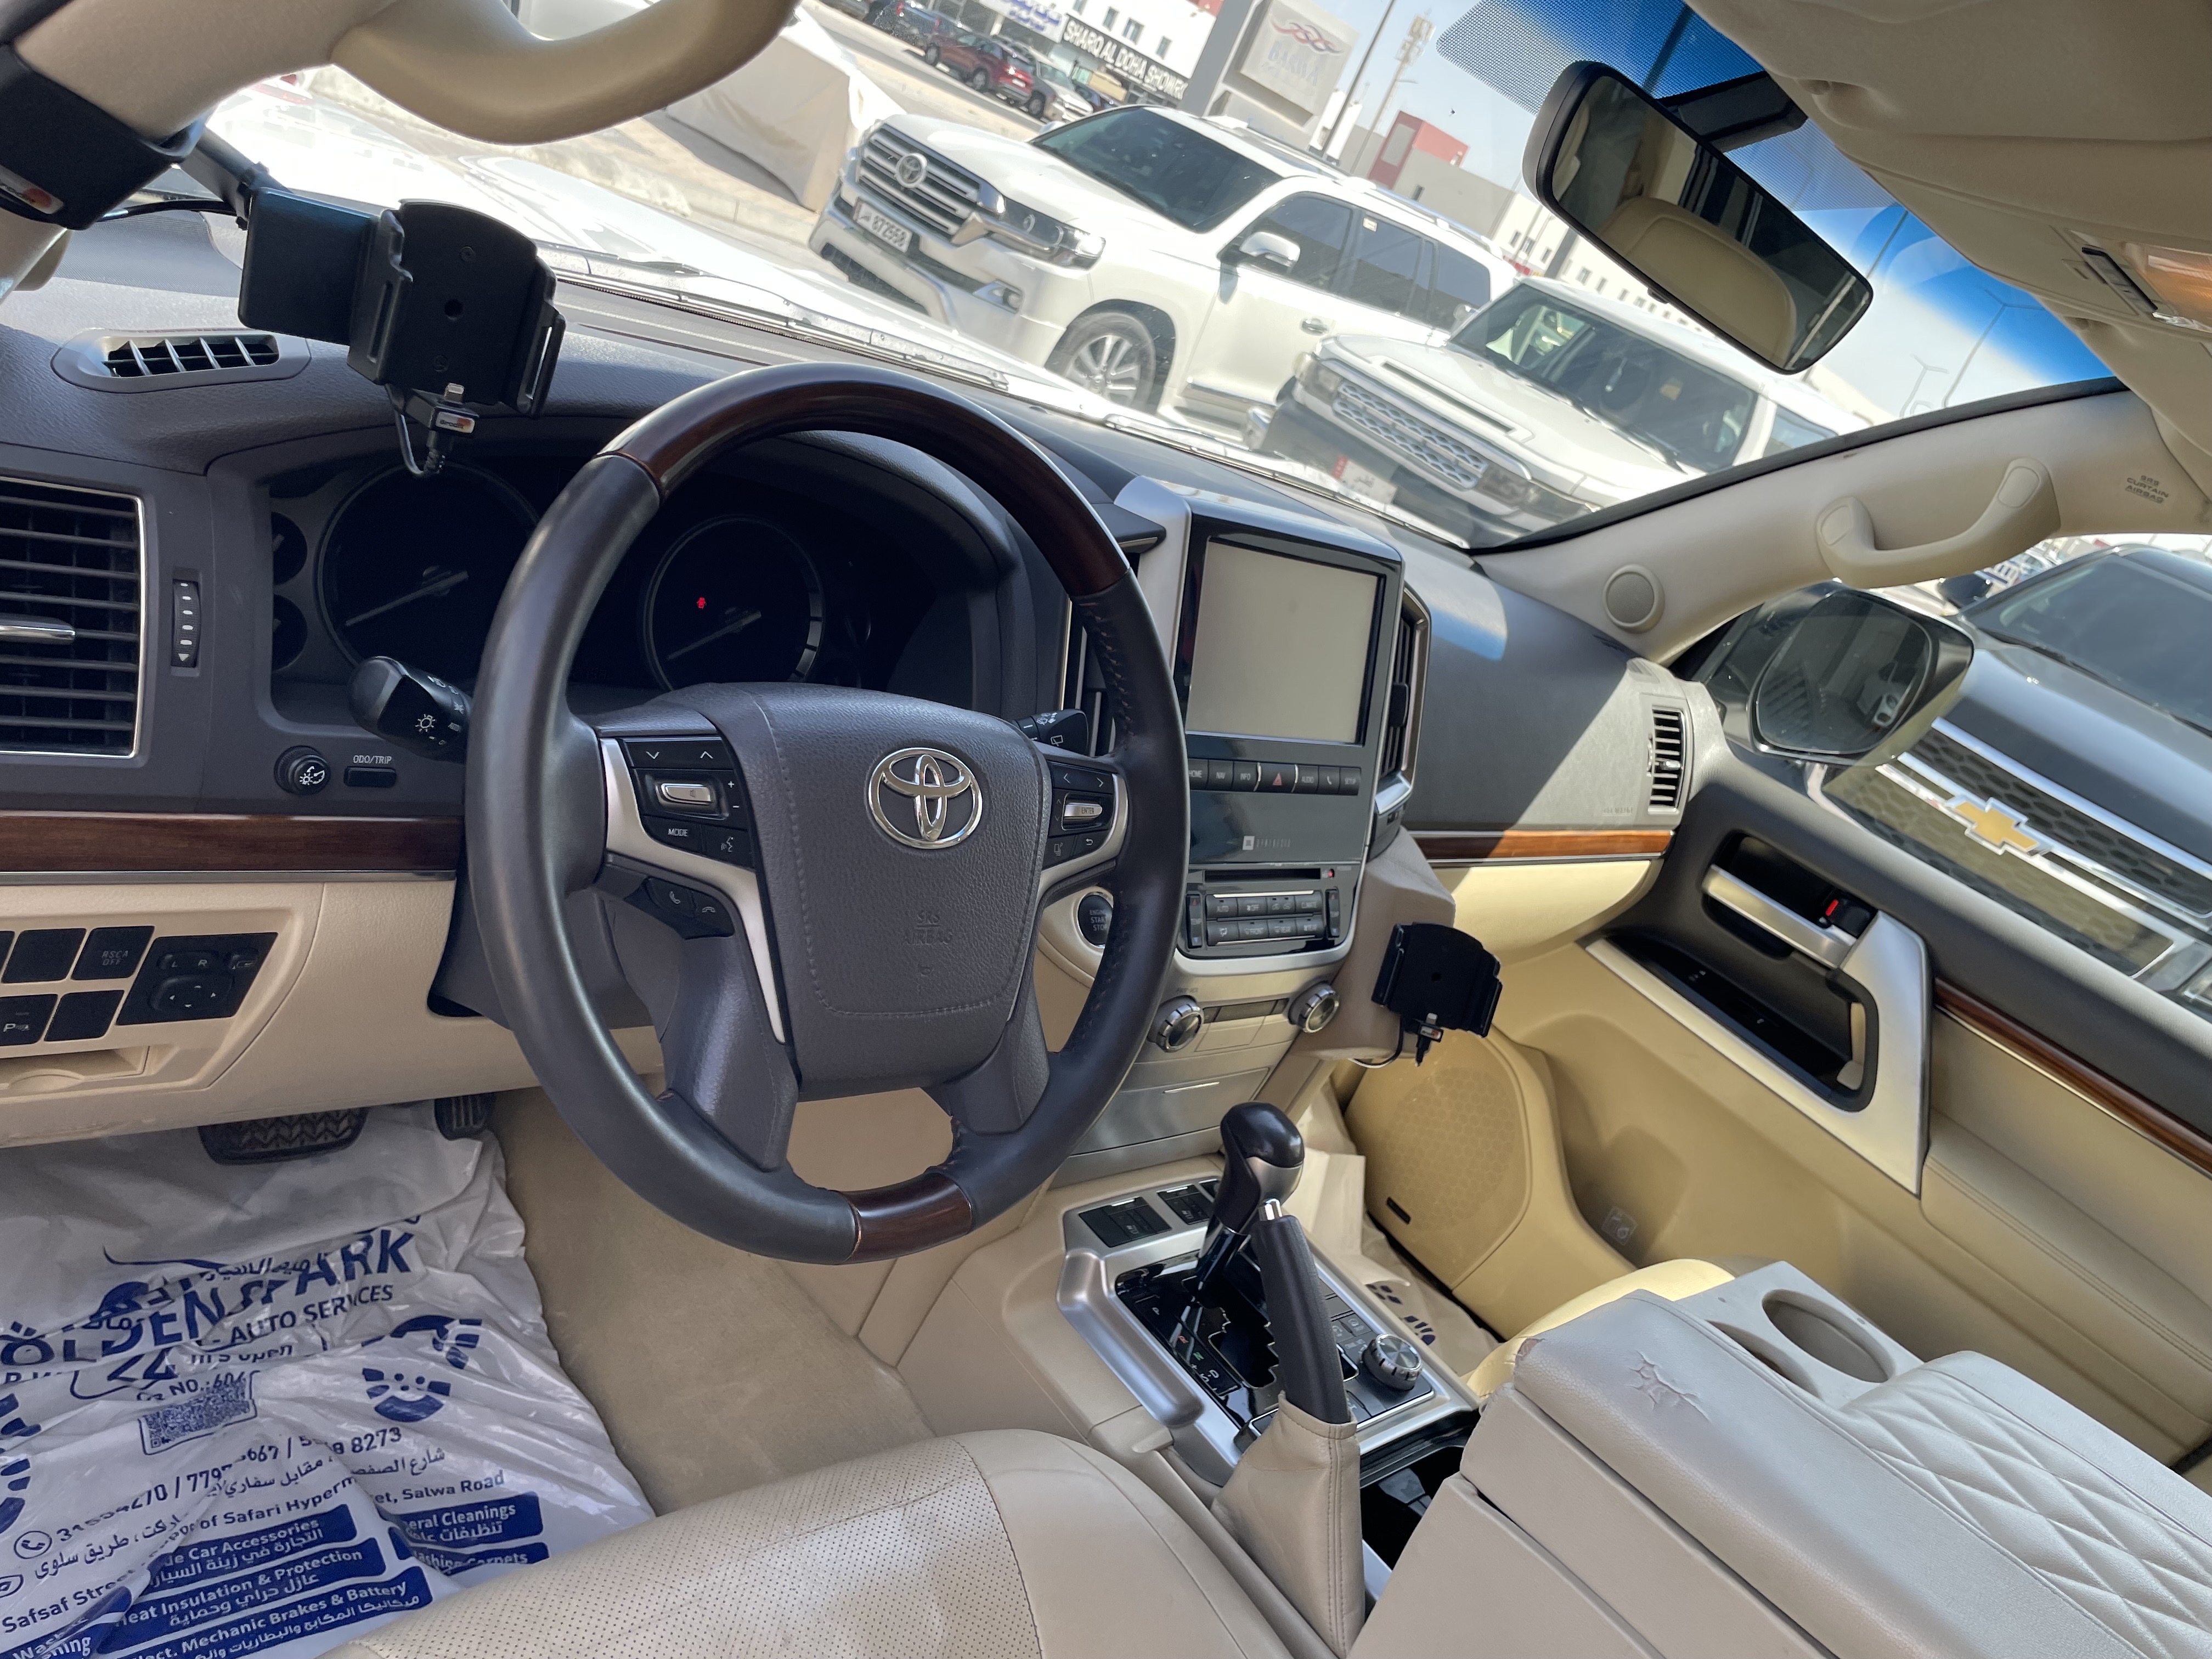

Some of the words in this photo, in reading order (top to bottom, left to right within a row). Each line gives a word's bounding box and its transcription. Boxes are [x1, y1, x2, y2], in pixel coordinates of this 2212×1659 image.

[1114, 47, 1148, 78] DOHA
[2126, 477, 2169, 498] CURTAIN
[353, 755, 392, 765] ODO/TRIP
[668, 828, 688, 837] MODE
[101, 950, 129, 958] RSCA
[230, 1311, 297, 1345] AUTO
[351, 1426, 402, 1453] 8273
[441, 1503, 516, 1526] Cleanings
[2, 1597, 69, 1633] Safsaf
[200, 1515, 218, 1529] of
[223, 1504, 281, 1525] Safari
[403, 1487, 456, 1500] Salwa
[461, 1470, 504, 1492] Road
[188, 1545, 218, 1561] Car
[222, 1519, 320, 1554] Accessories
[161, 1581, 253, 1616] Insulation
[258, 1575, 272, 1585] &
[274, 1550, 363, 1581] Protection
[181, 1618, 267, 1653] Mechanic
[269, 1600, 328, 1625] Brakes
[331, 1594, 344, 1606] &
[346, 1581, 407, 1601] Battery
